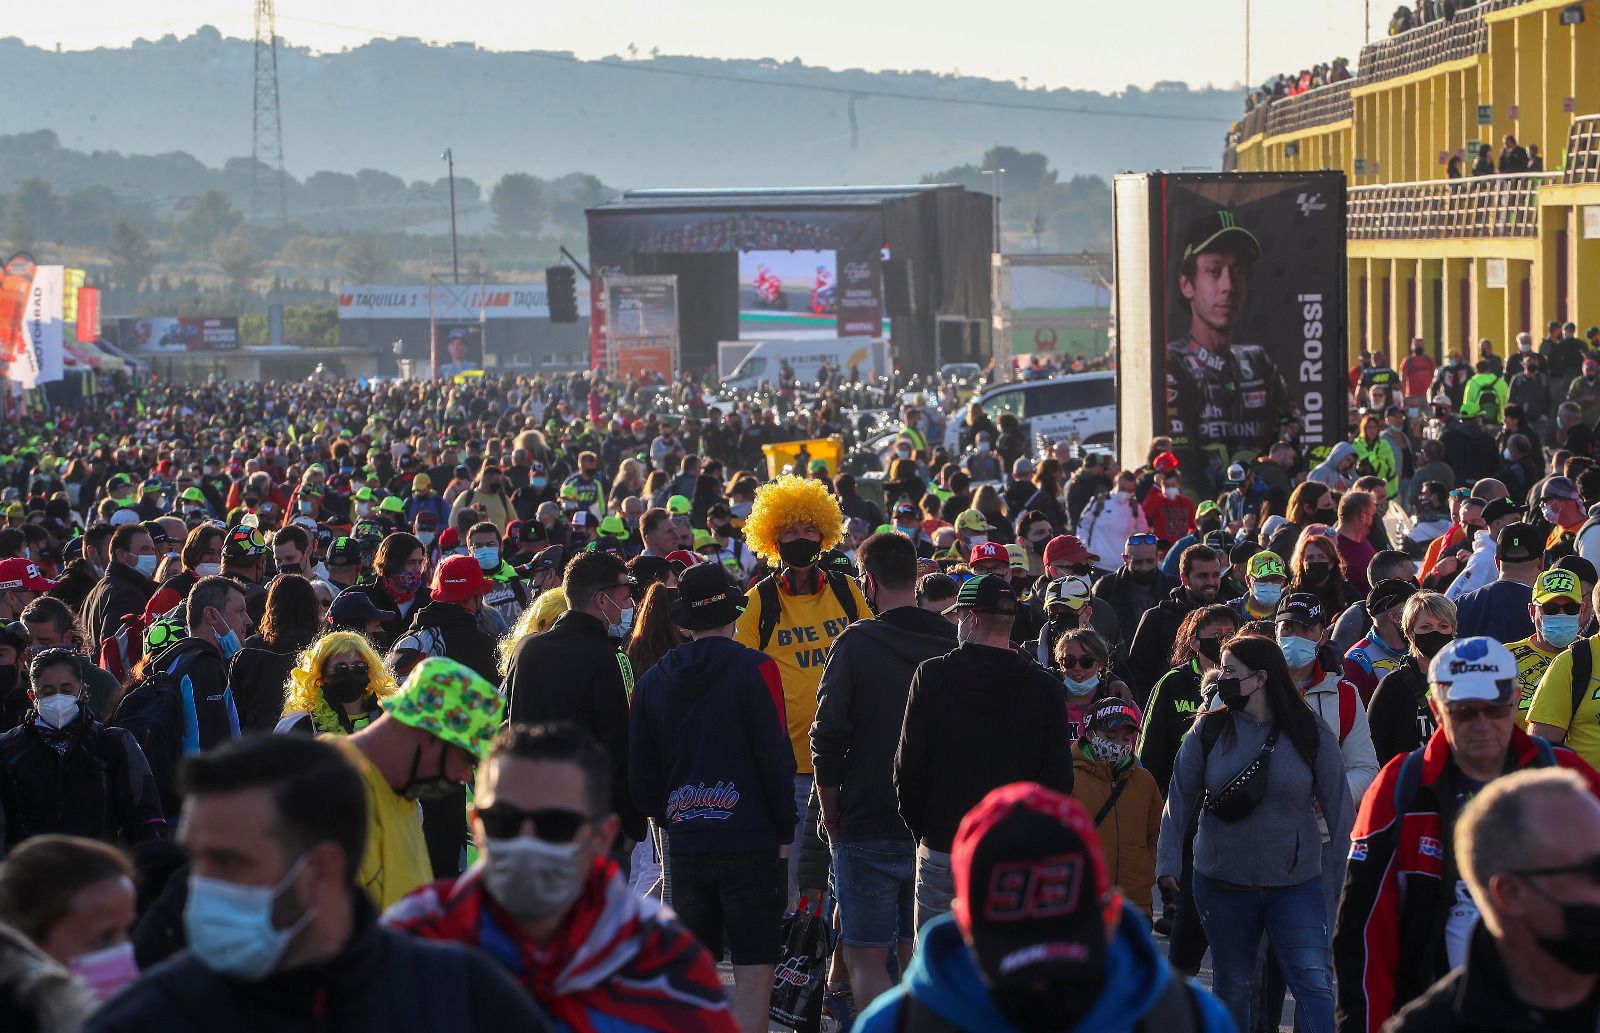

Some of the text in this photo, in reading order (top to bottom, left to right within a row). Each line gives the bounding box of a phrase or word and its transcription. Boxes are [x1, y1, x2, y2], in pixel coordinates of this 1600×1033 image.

[356, 293, 418, 309] TAQUILLA 1
[1298, 293, 1324, 456] ino Rossi
[1545, 577, 1575, 592] 46
[777, 626, 820, 647] BYE
[679, 780, 740, 810] Diablo
[984, 853, 1085, 922] 93
